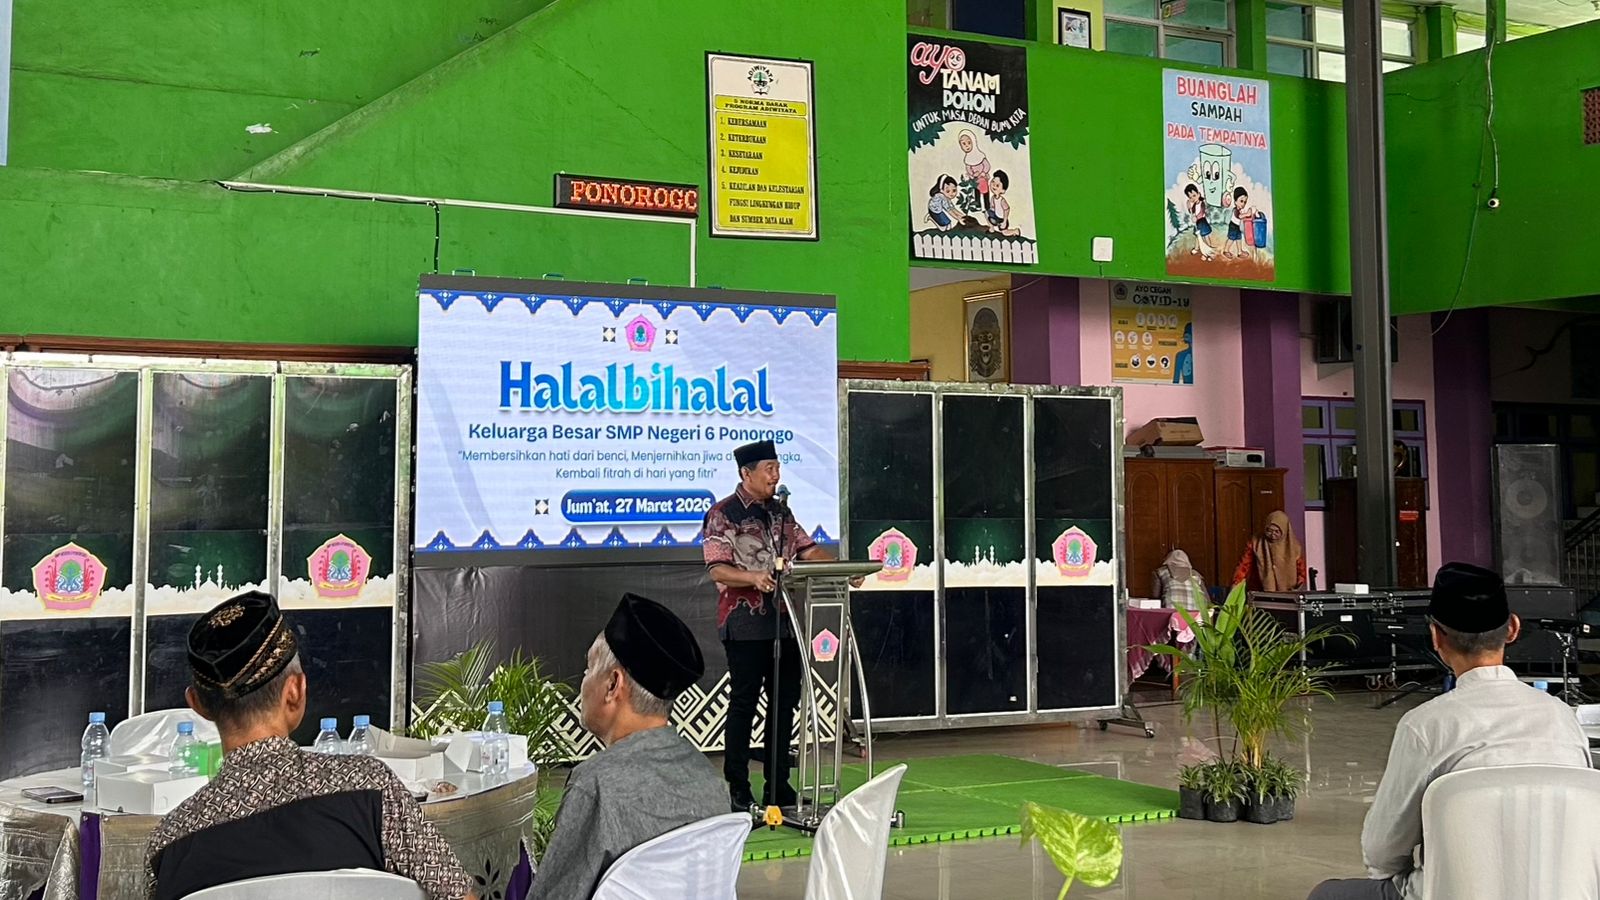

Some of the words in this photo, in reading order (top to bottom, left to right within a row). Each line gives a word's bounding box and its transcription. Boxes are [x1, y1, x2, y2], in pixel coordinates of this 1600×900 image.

[747, 65, 774, 83] ADIWIYATA
[911, 42, 966, 85] ayo
[940, 68, 1000, 95] TANAM
[1177, 76, 1257, 105] BUANGLAH
[725, 103, 758, 111] PROGRAM
[760, 106, 797, 114] ADIWIYATA
[740, 99, 764, 107] NORMA
[943, 89, 995, 114] POHON
[1191, 101, 1242, 122] SAMPAH
[728, 117, 767, 128] KEBERSAMAAN
[912, 110, 941, 133] UNTUK
[942, 109, 966, 122] MASA
[968, 112, 990, 129] DEPAN
[991, 120, 1011, 133] BUMI
[1009, 107, 1027, 128] KITA
[1167, 123, 1196, 140] PADA
[1199, 127, 1267, 149] TEMPATNYA
[730, 214, 740, 223] DAN
[741, 214, 763, 224] SUMBER
[498, 360, 775, 416] Halalbihalal
[469, 423, 548, 442] Keluarga
[552, 424, 601, 440] Besar
[606, 425, 643, 440] SMP
[648, 425, 700, 443] Negeri
[705, 426, 715, 440] 6
[719, 426, 794, 444] Ponorogo
[549, 450, 570, 461] hati
[572, 450, 594, 461] dari
[597, 450, 628, 463] benci,
[631, 450, 700, 464] Menjernihkan
[702, 450, 722, 464] jiwa
[555, 467, 600, 479] Kembali
[603, 467, 631, 479] fitrah
[634, 467, 643, 479] di
[646, 468, 666, 479] hari
[669, 471, 695, 481] yang
[567, 498, 612, 515] Jum'at,
[615, 497, 633, 513] 27
[636, 497, 672, 513] Maret
[676, 497, 711, 512] 2026
